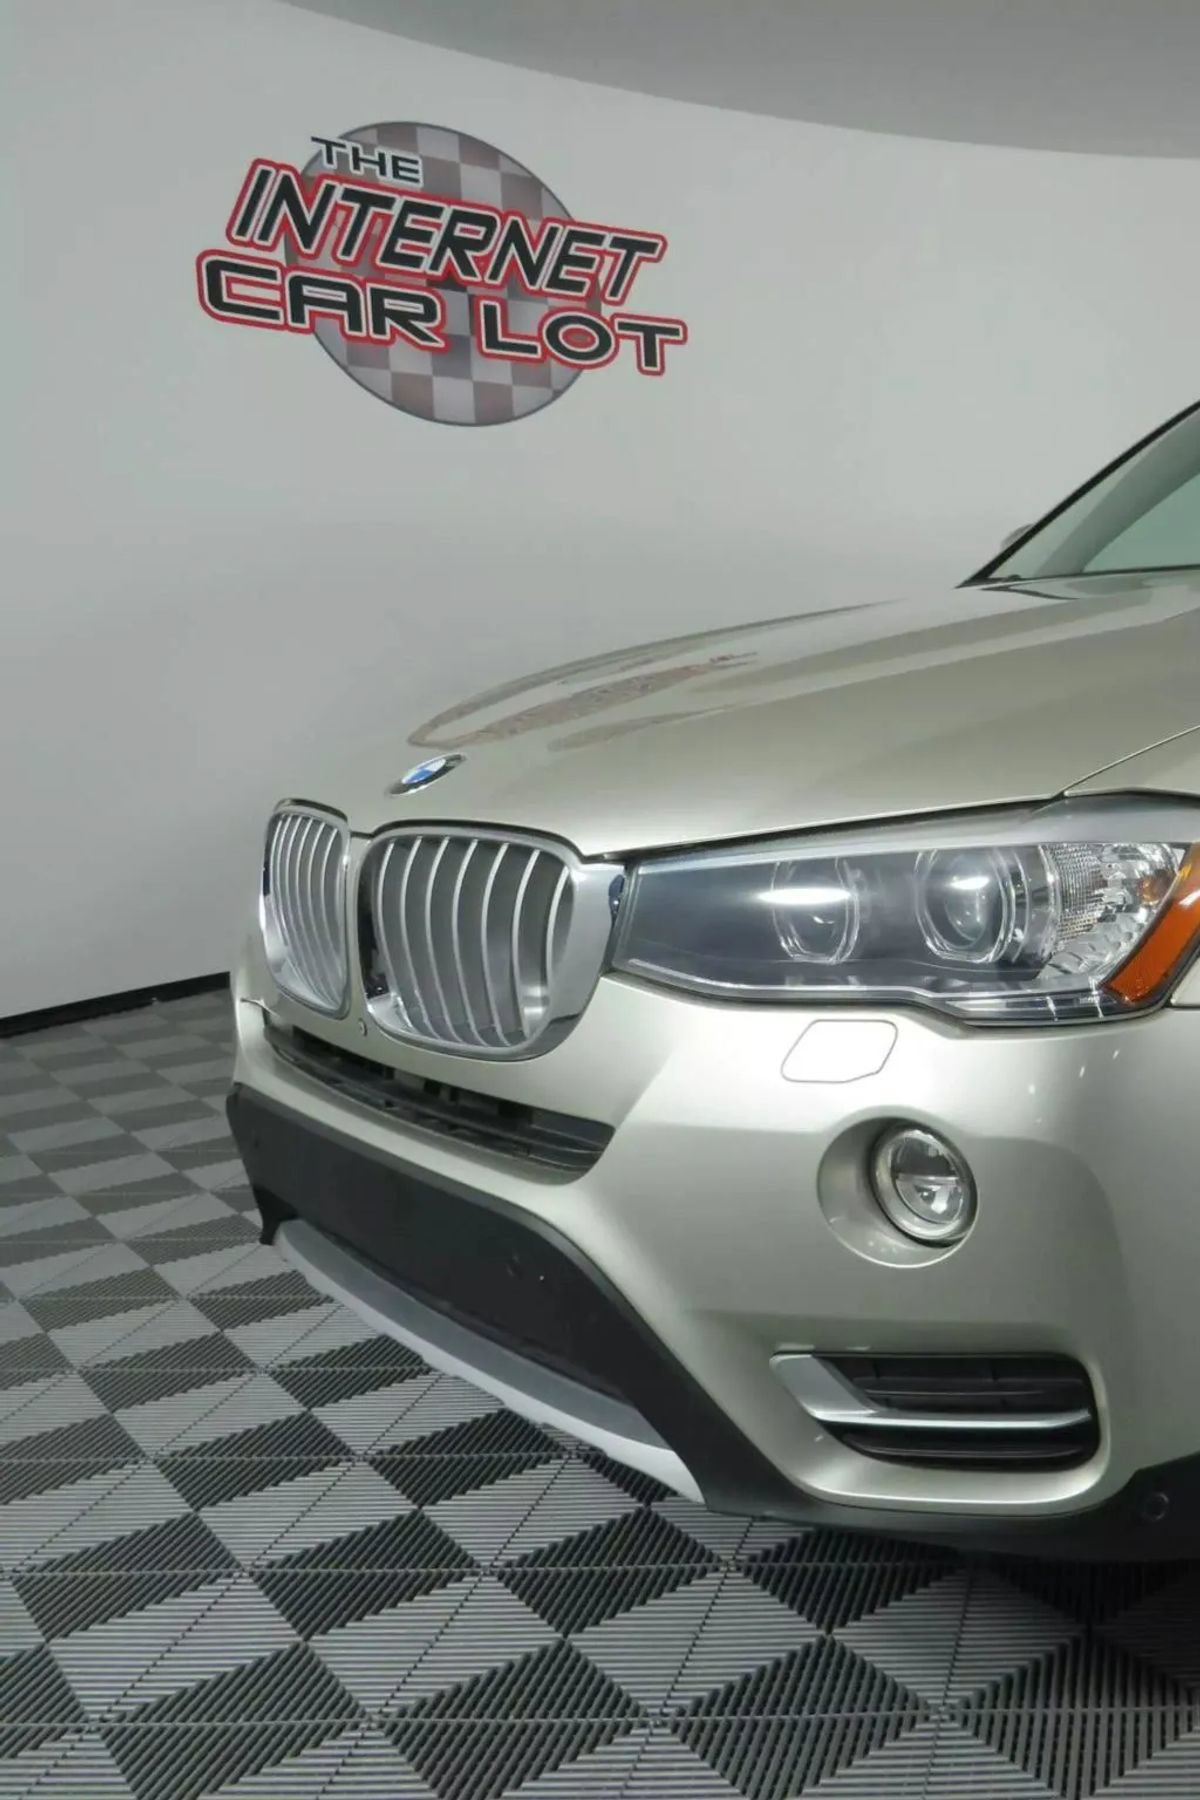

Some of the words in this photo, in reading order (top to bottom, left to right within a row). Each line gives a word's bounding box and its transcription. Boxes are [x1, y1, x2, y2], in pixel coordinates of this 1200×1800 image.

[311, 136, 422, 185] THE
[230, 162, 664, 302] INTERNET
[200, 254, 447, 349] CAR
[477, 296, 685, 372] LOT
